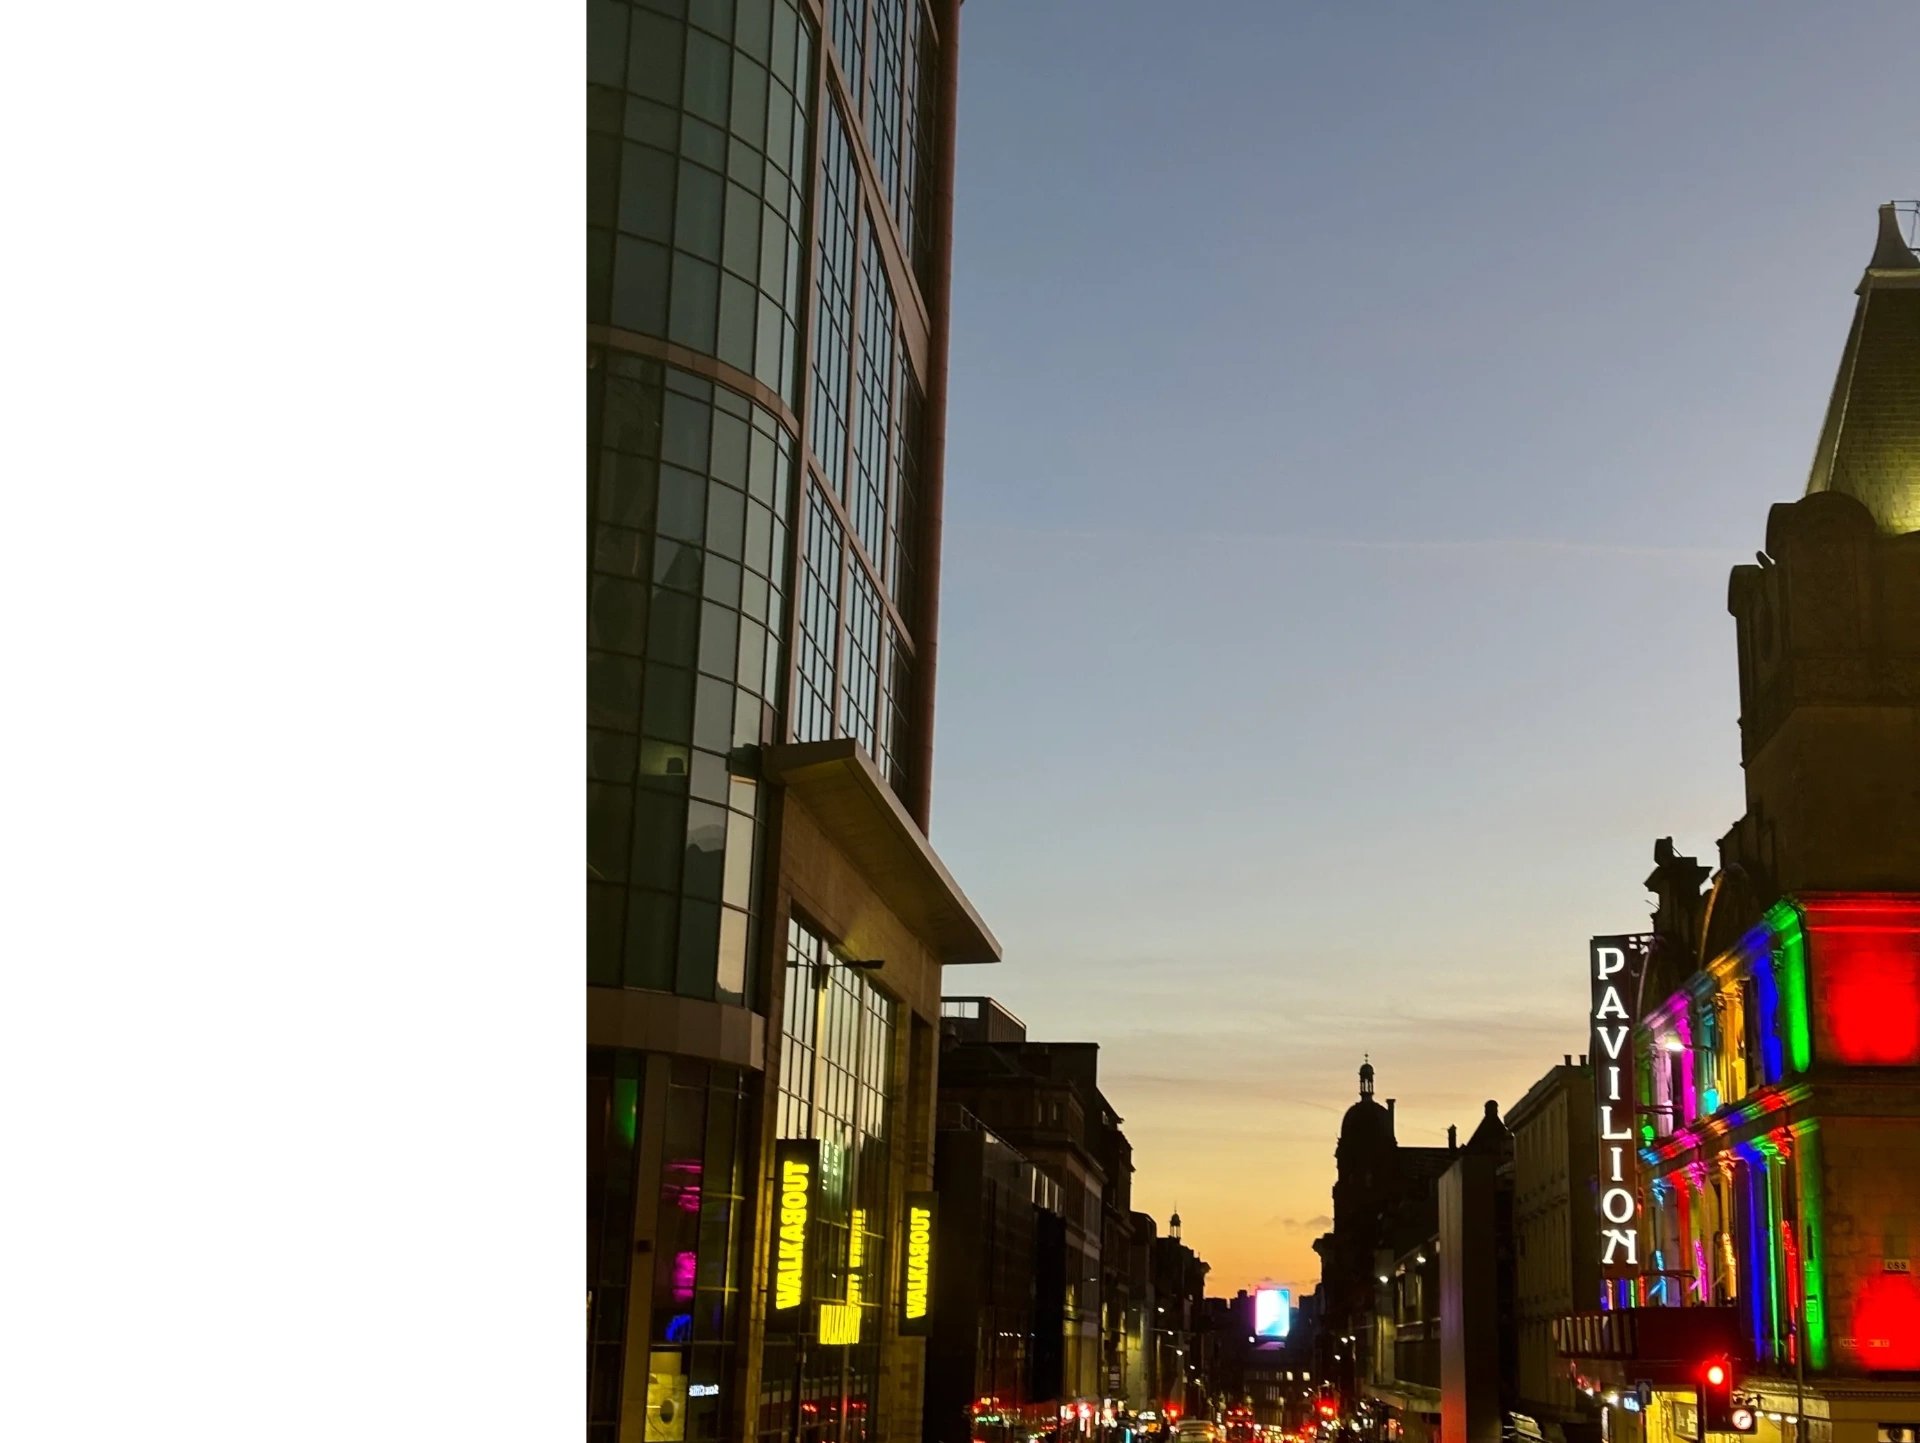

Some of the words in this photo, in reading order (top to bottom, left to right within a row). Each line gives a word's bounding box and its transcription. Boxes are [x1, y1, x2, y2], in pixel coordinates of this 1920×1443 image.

[1595, 946, 1639, 1265] PAVILION
[776, 1160, 810, 1310] WALKABOUT
[906, 1207, 931, 1319] WALKABOUT
